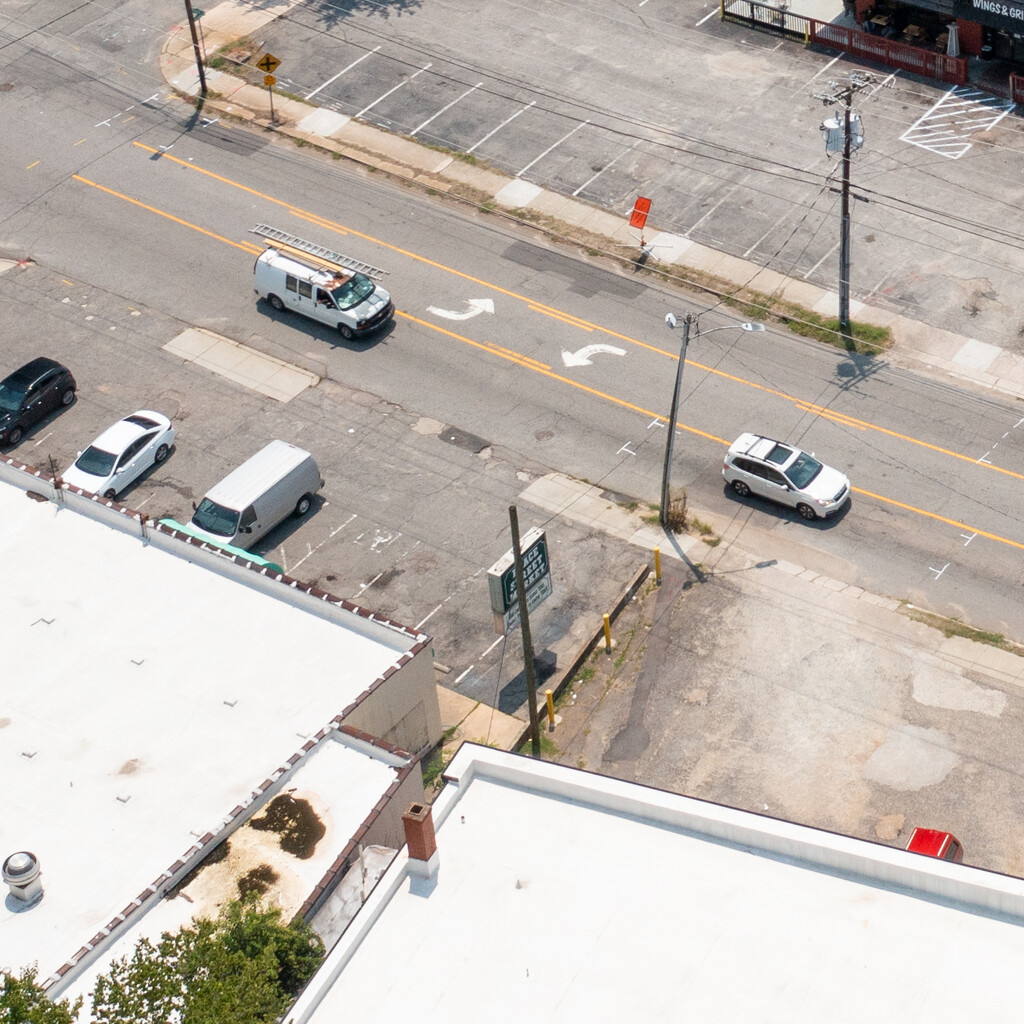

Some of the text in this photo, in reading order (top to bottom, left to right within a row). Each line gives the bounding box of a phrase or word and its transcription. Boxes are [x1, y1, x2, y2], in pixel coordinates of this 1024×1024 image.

[1001, 5, 1009, 17] &
[510, 553, 543, 592] SREET
[511, 546, 540, 579] PACE
[509, 562, 546, 601] MRKET
